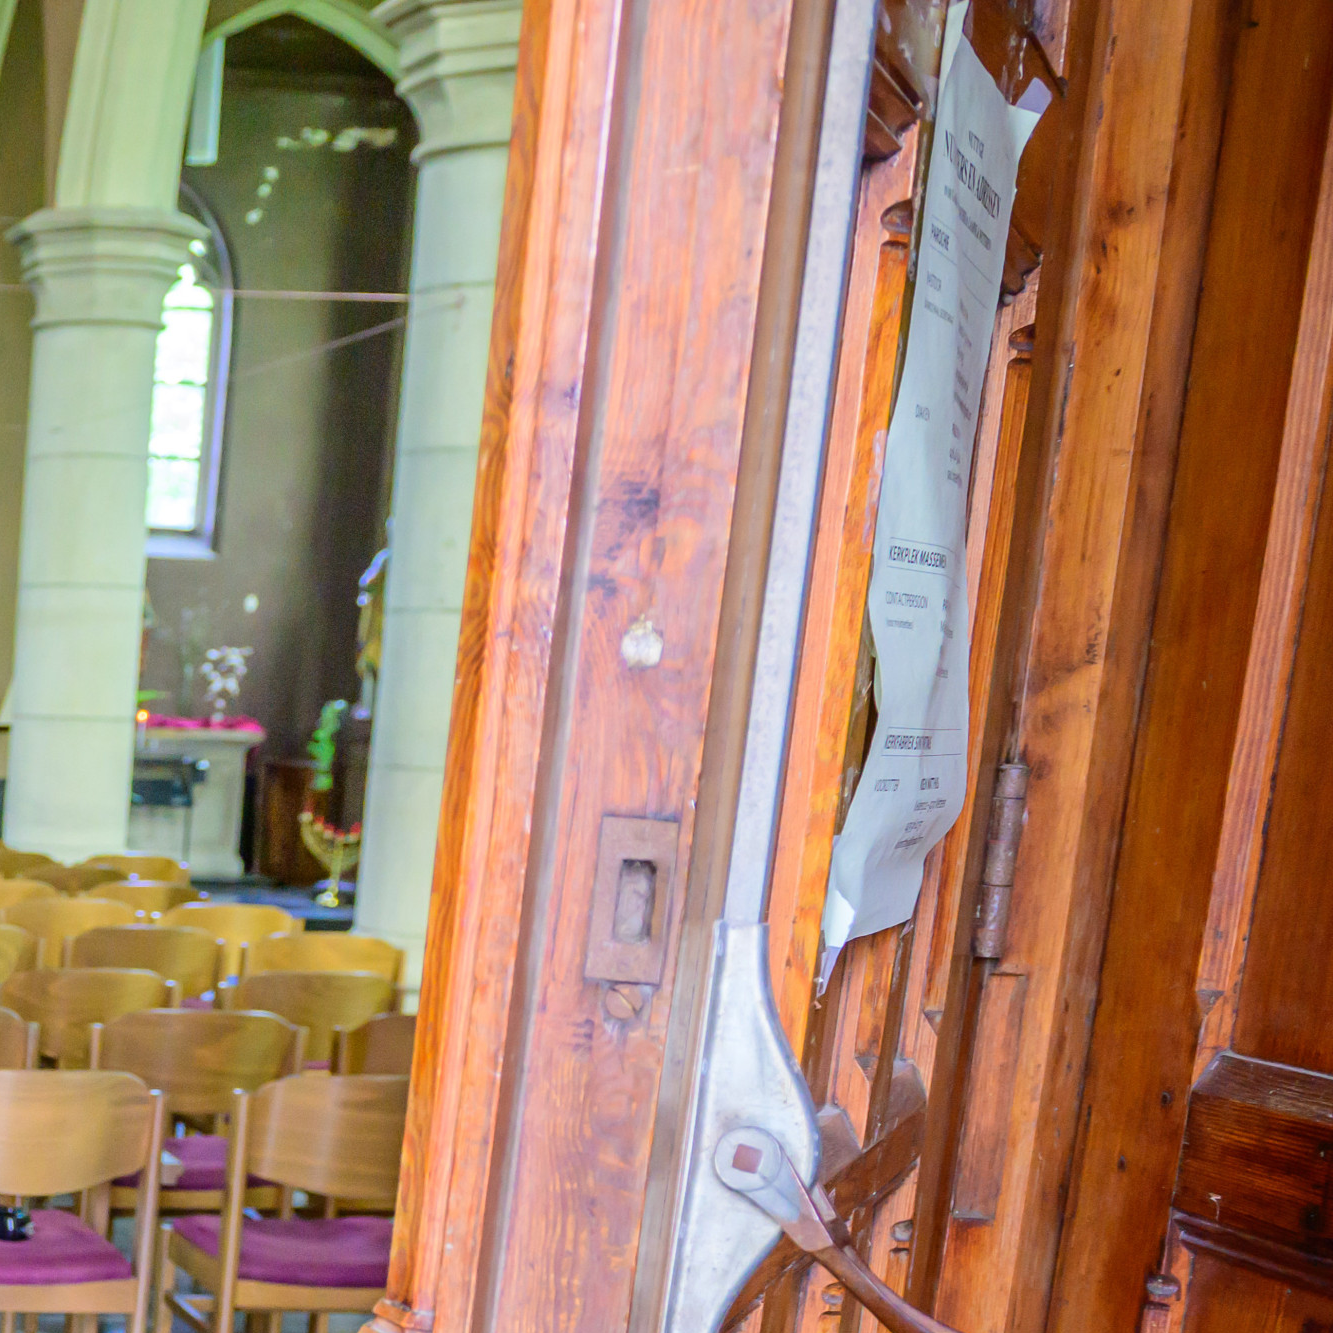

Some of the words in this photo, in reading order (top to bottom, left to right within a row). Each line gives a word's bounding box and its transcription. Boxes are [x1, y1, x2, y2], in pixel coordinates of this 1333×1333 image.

[889, 545, 919, 564] KERKPLEK
[919, 550, 947, 569] MASSEMEN
[886, 591, 928, 609] CONTACTPERSOON
